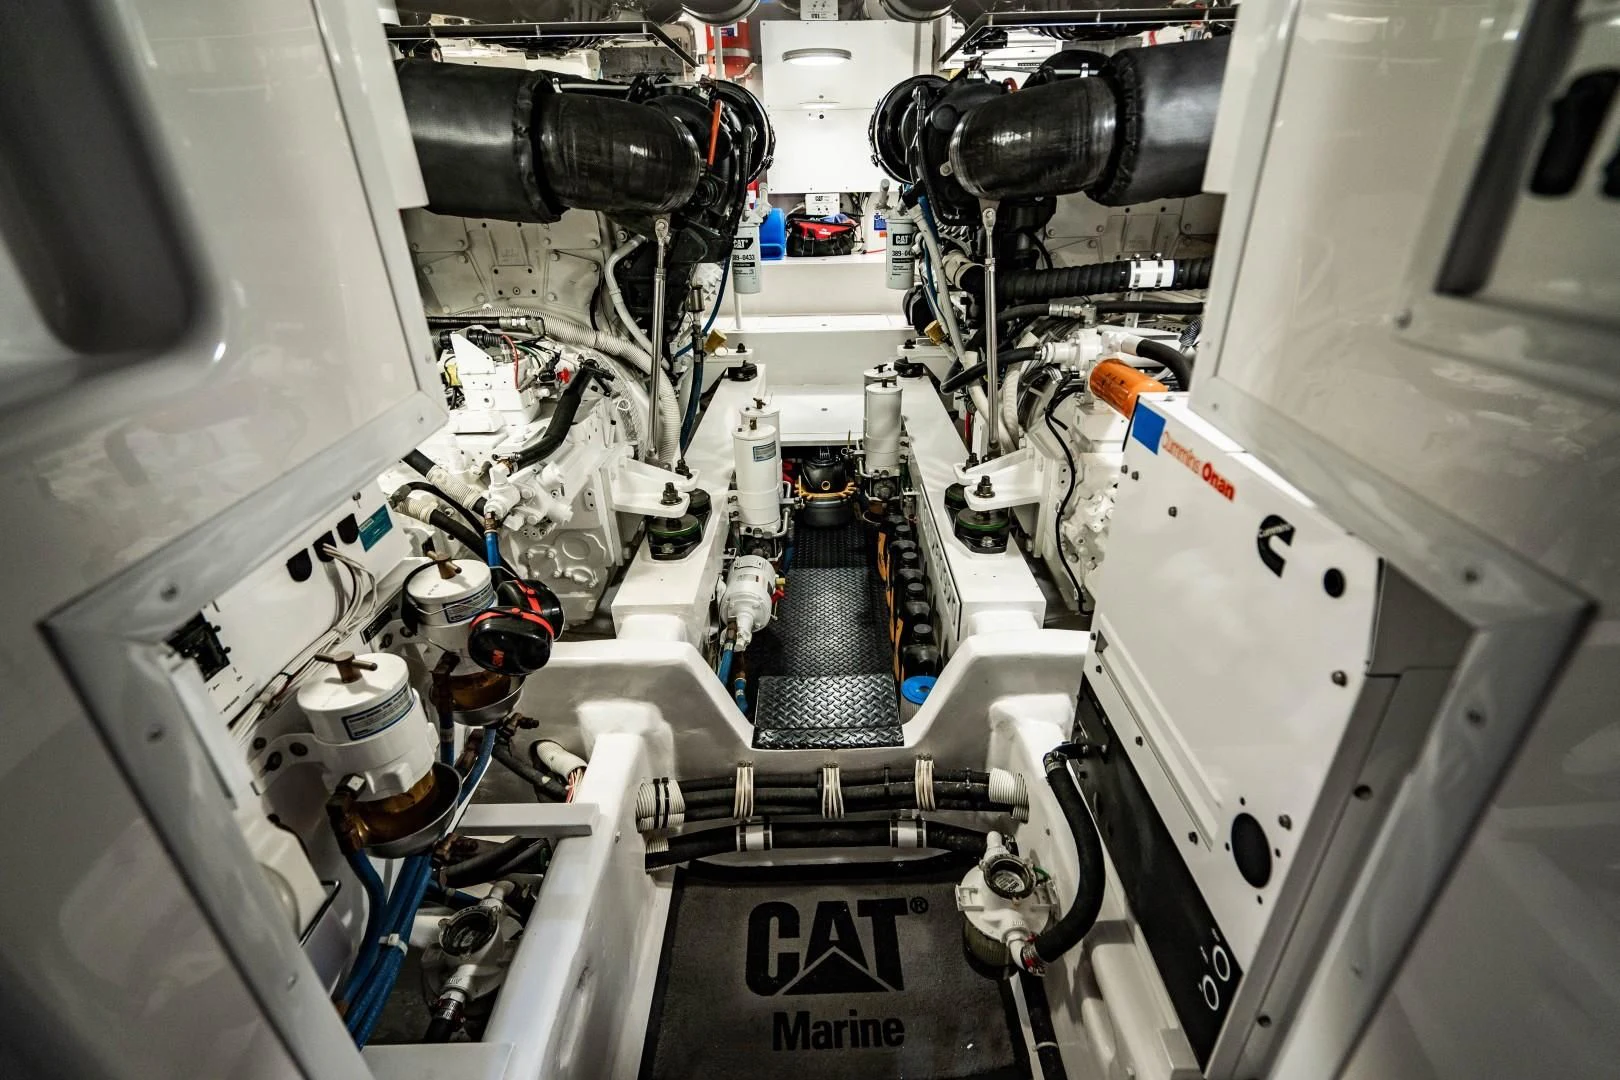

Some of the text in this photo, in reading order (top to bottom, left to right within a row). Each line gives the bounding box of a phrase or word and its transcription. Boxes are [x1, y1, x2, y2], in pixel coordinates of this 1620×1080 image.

[896, 235, 908, 244] CAT
[1202, 462, 1235, 502] Onan
[773, 1009, 905, 1051] Marine
